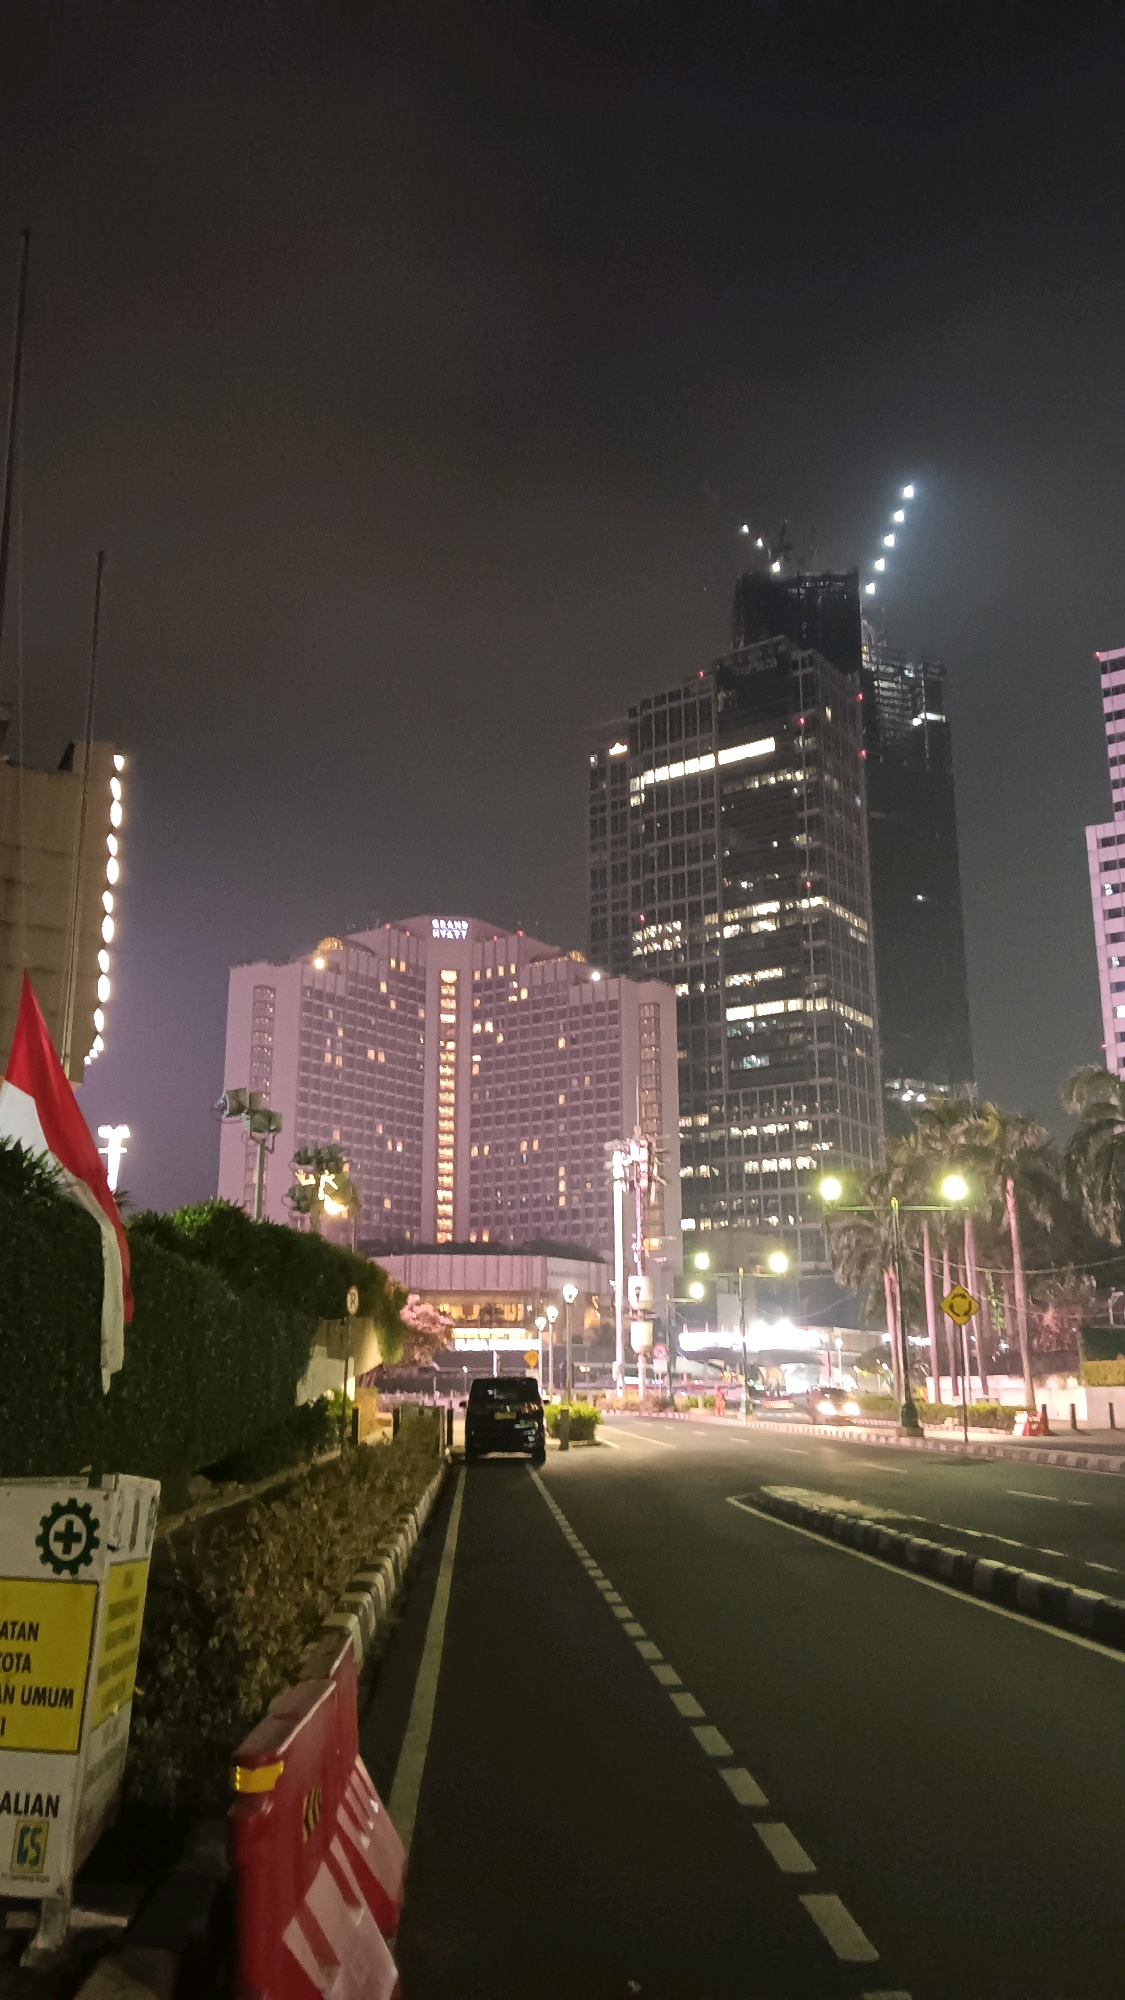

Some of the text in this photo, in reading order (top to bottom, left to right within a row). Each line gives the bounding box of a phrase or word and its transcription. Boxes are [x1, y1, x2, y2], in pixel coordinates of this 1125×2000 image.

[431, 919, 469, 930] GRAND
[0, 1652, 31, 1673] OTA
[0, 1683, 74, 1709] N UMUM
[0, 1790, 60, 1818] ALIAN
